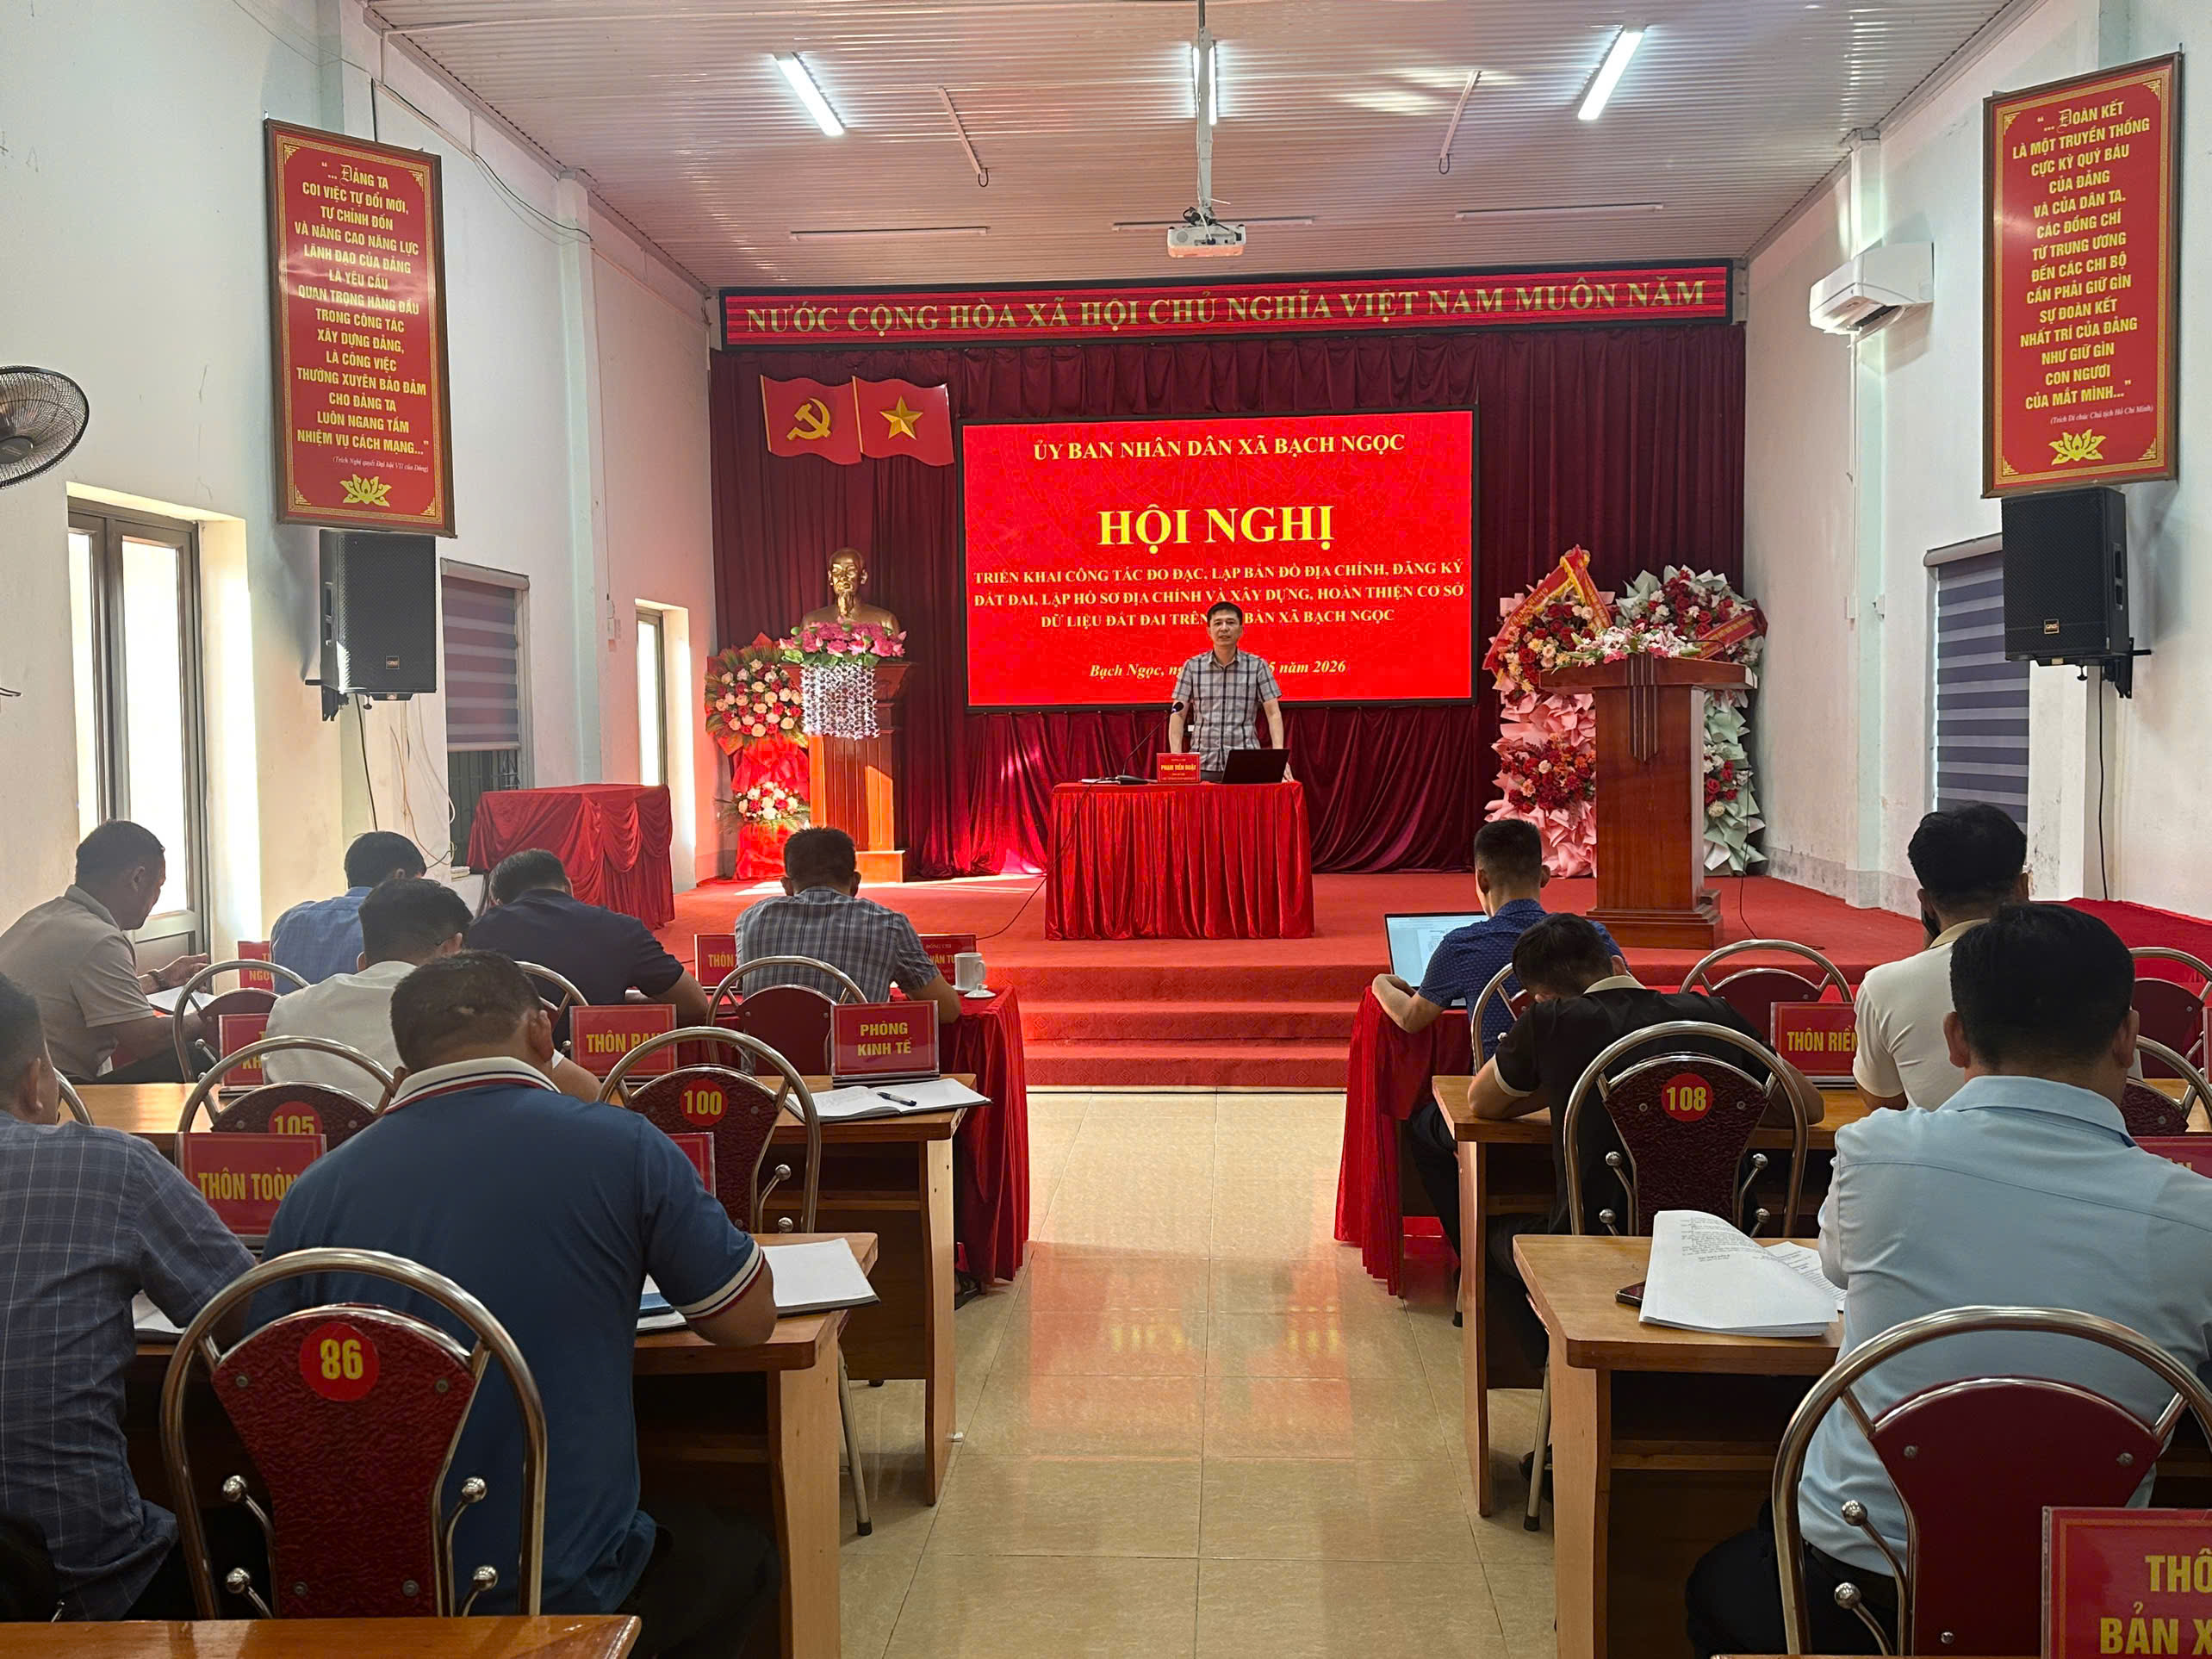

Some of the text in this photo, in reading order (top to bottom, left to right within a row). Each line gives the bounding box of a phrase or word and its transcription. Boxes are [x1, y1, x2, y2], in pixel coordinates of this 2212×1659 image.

[2101, 98, 2124, 119] KẾT
[2012, 117, 2150, 159] LÀ MỘT TRUYỀN THỐNG
[2031, 144, 2129, 177] CỰC KỲ QUÝ BÁU
[377, 175, 388, 190] TA
[2049, 169, 2109, 194] CỦA ĐẢNG
[302, 182, 408, 214] COI VIỆC TỰ ĐỔI MỚI,
[320, 205, 393, 230] TỰ CHỈNH ĐỐN
[295, 221, 419, 256] VÀ NÂNG CAO NĂNG LỰC
[2033, 233, 2127, 261] TỪ TRUNG ƯƠNG
[2032, 251, 2127, 283] ĐẾN CÁC CHI BỘ
[2027, 273, 2132, 304] CẦN PHẢI GIỮ GÌN
[746, 276, 1706, 337] NƯỚC CỘNG HÒA XÃ HỘI CHỦ NGHĨA VIỆT NAM MUÔN NĂM
[2040, 295, 2117, 323] SỰ ĐOÀN KẾT
[316, 308, 404, 332] TRONG CÔNG TÁC
[2020, 315, 2137, 348] NHẤT TRÍ CỦA ĐẢNG
[317, 329, 404, 354] XÂY DỰNG ĐẢNG,
[296, 367, 426, 395] THƯỜNG XUYÊN BẢO ĐẢM
[2045, 371, 2070, 386] CON
[329, 392, 396, 412] CHO ĐẢNG TA
[2025, 387, 2078, 410] CỦA MẮT
[317, 410, 409, 433] LUÔN NGANG TẦM
[297, 430, 380, 450] NHIỆM VỤ CÁCH
[1034, 434, 1405, 460] ỦY BAN NHÂN DÂN XÃ BẠCH NGỌC
[1097, 504, 1335, 555] HỘI NGHỊ
[1023, 570, 1061, 583] KHAI
[1066, 568, 1109, 582] CÔNG
[1113, 566, 1142, 581] TÁC
[1146, 569, 1169, 581] ĐO
[1305, 565, 1330, 581] ĐỊA
[1393, 561, 1436, 575] ĐĂNG
[1441, 560, 1463, 574] KÝ
[1100, 592, 1120, 604] SƠ
[1123, 592, 1148, 606] ĐỊA
[1153, 589, 1202, 603] CHÍNH
[1206, 587, 1226, 602] VÀ
[1230, 587, 1259, 602] XÂY
[1318, 585, 1361, 600] HOÀN
[1365, 585, 1413, 600] THIỆN
[1418, 584, 1440, 598] CƠ
[1444, 582, 1464, 597] SỞ
[1067, 613, 1102, 630] LIỆU
[1140, 614, 1165, 625] ĐAI
[1170, 611, 1208, 625] TRÊN
[1279, 608, 1300, 623] XÃ
[1304, 610, 1345, 625] BẠCH
[1351, 610, 1395, 624] NGỌC
[1090, 664, 1122, 680] Bạch
[1280, 662, 1308, 674] năm
[1313, 660, 1346, 672] 2026
[861, 1020, 908, 1036] PHÒNG
[1786, 1027, 1824, 1052] THÔN
[586, 1029, 626, 1053] THÔN
[857, 1037, 911, 1056] KINH TẾ
[684, 1090, 722, 1115] 100
[1666, 1087, 1706, 1111] 108
[274, 1115, 315, 1134] 105
[197, 1166, 245, 1199] THÔN
[320, 1339, 363, 1380] 86
[2144, 1548, 2212, 1593] THÔ
[2100, 1601, 2178, 1655] BẢN
